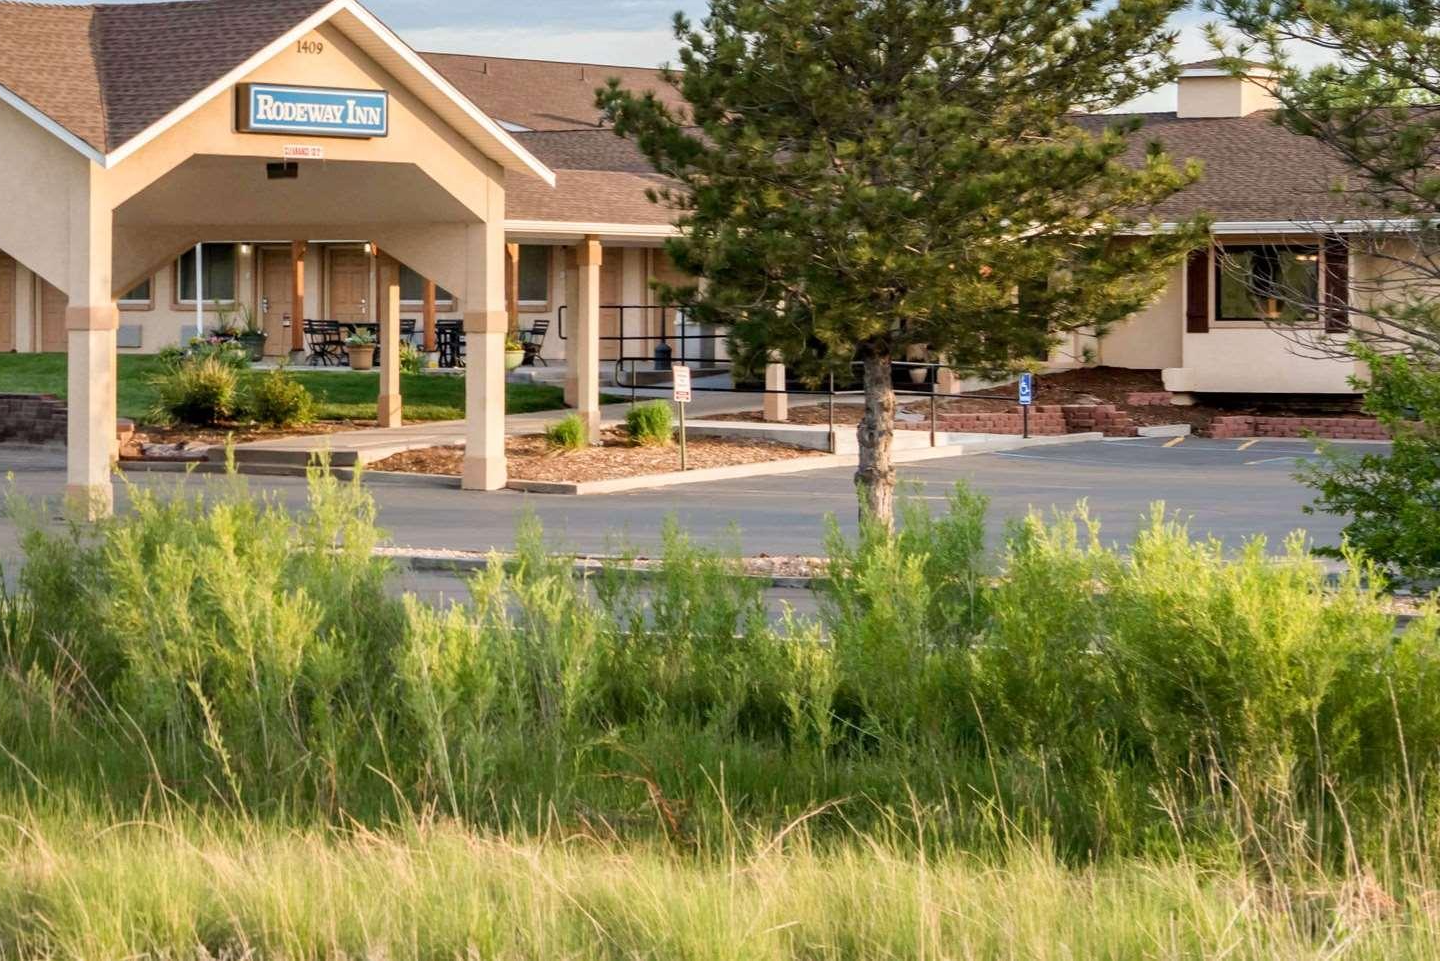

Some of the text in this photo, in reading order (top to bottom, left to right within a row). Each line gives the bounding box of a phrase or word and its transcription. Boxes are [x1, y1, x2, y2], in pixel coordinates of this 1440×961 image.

[296, 40, 324, 55] 1409
[256, 94, 381, 125] RODEWAY INN
